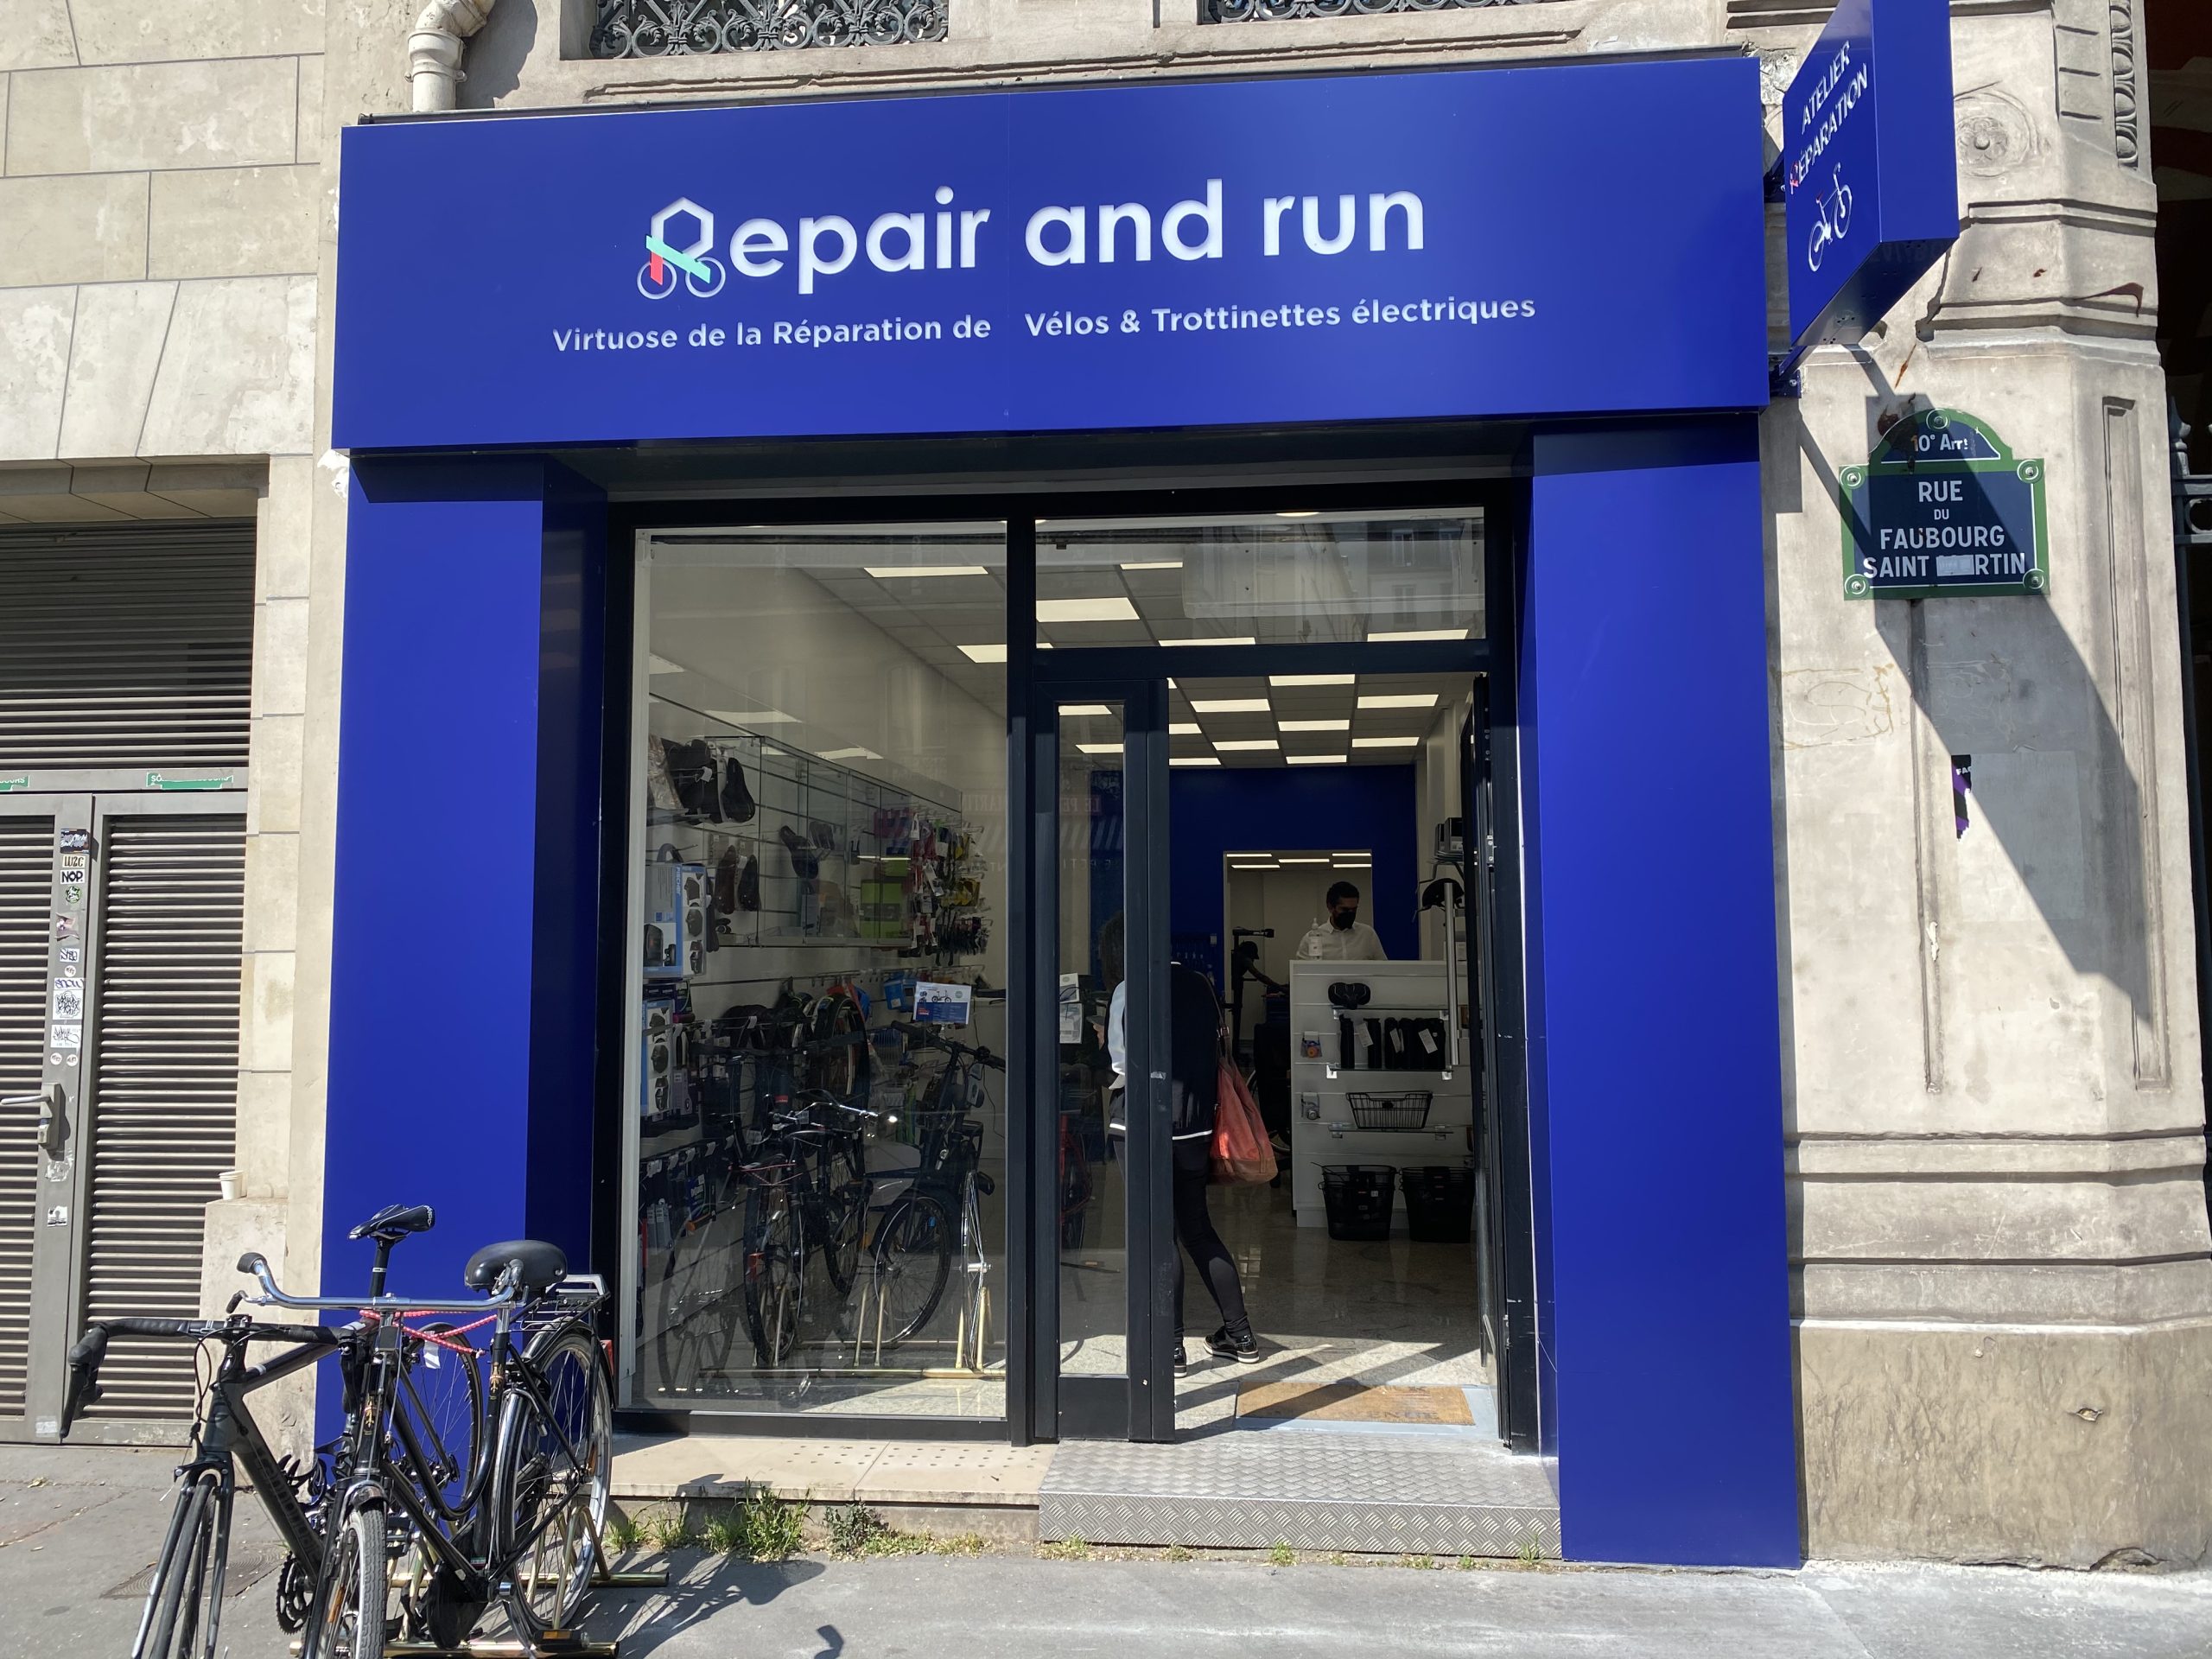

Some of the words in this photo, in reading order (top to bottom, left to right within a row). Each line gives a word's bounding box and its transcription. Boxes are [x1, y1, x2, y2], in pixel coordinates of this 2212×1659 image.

[1802, 40, 1851, 135] ATELIER
[1789, 62, 1868, 195] RÉPARATION
[637, 186, 991, 300] Repair
[1025, 178, 1224, 267] and
[1263, 190, 1424, 257] run
[553, 327, 678, 352] Virtuose
[688, 323, 726, 347] de
[737, 321, 761, 346] la
[773, 316, 942, 348] Réparation
[952, 315, 991, 339] de
[1024, 310, 1109, 337] Vélos
[1120, 309, 1141, 334] &
[1151, 303, 1341, 332] Trottinettes
[1351, 296, 1535, 325] électriques
[1918, 480, 1963, 502] RUE
[1934, 508, 1949, 520] DU
[1880, 524, 2005, 550] FAUBOURG
[1863, 556, 1929, 578] SAINT
[1936, 553, 2025, 578] RTIN
